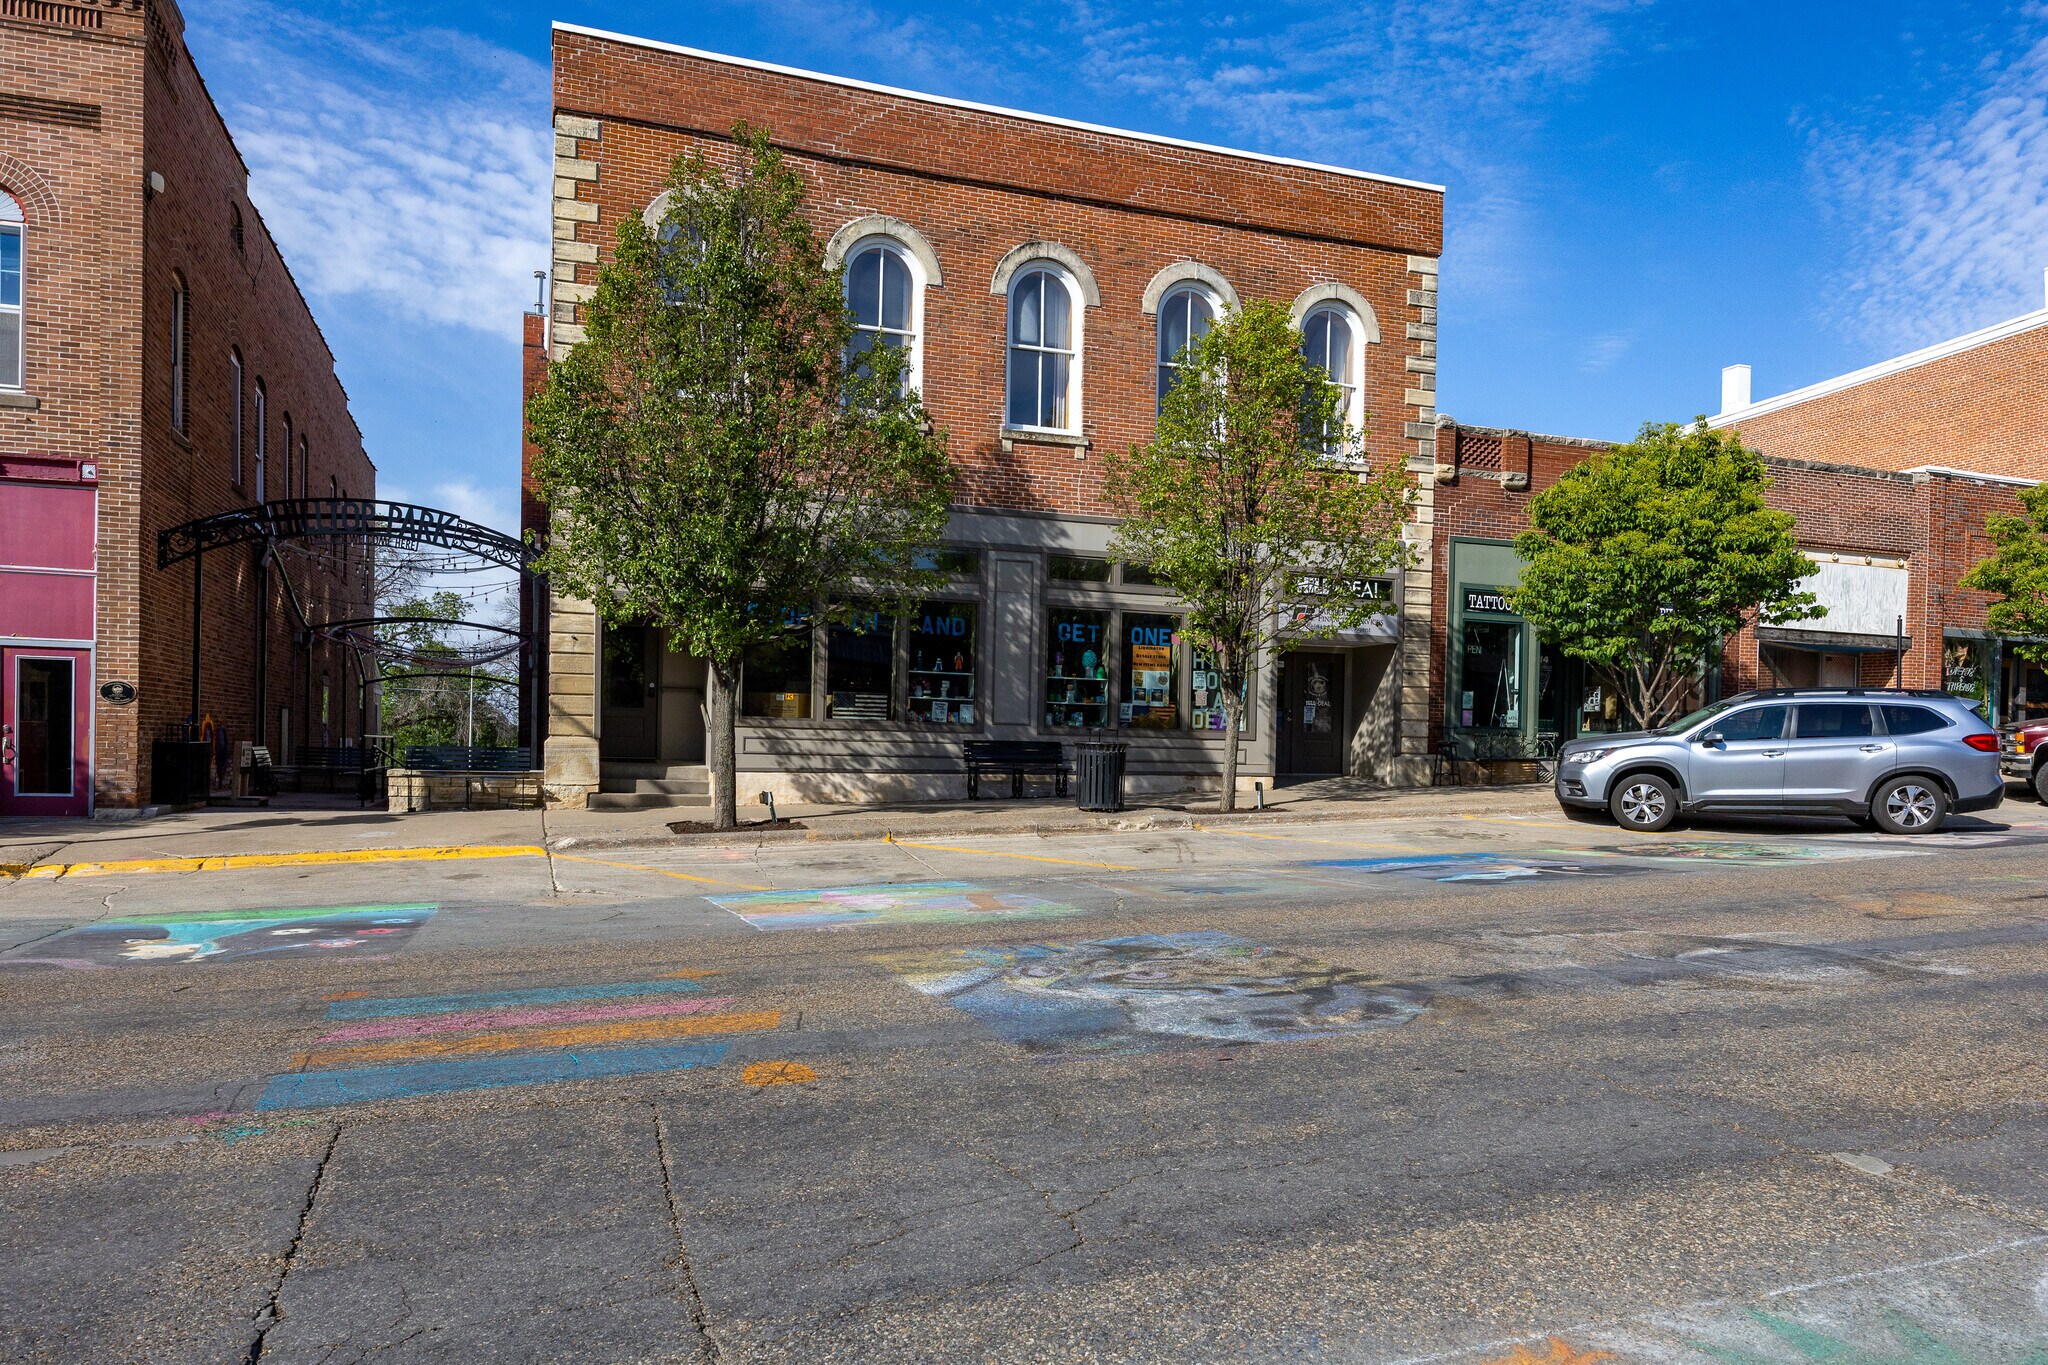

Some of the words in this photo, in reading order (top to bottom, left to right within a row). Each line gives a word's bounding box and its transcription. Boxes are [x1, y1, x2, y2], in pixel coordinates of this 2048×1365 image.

[387, 503, 460, 550] PARK
[395, 537, 416, 550] HERE
[921, 615, 966, 637] AND
[1057, 622, 1101, 643] GET
[1131, 627, 1172, 647] ONE
[1947, 682, 1975, 692] THREADS
[1191, 709, 1229, 730] DEA
